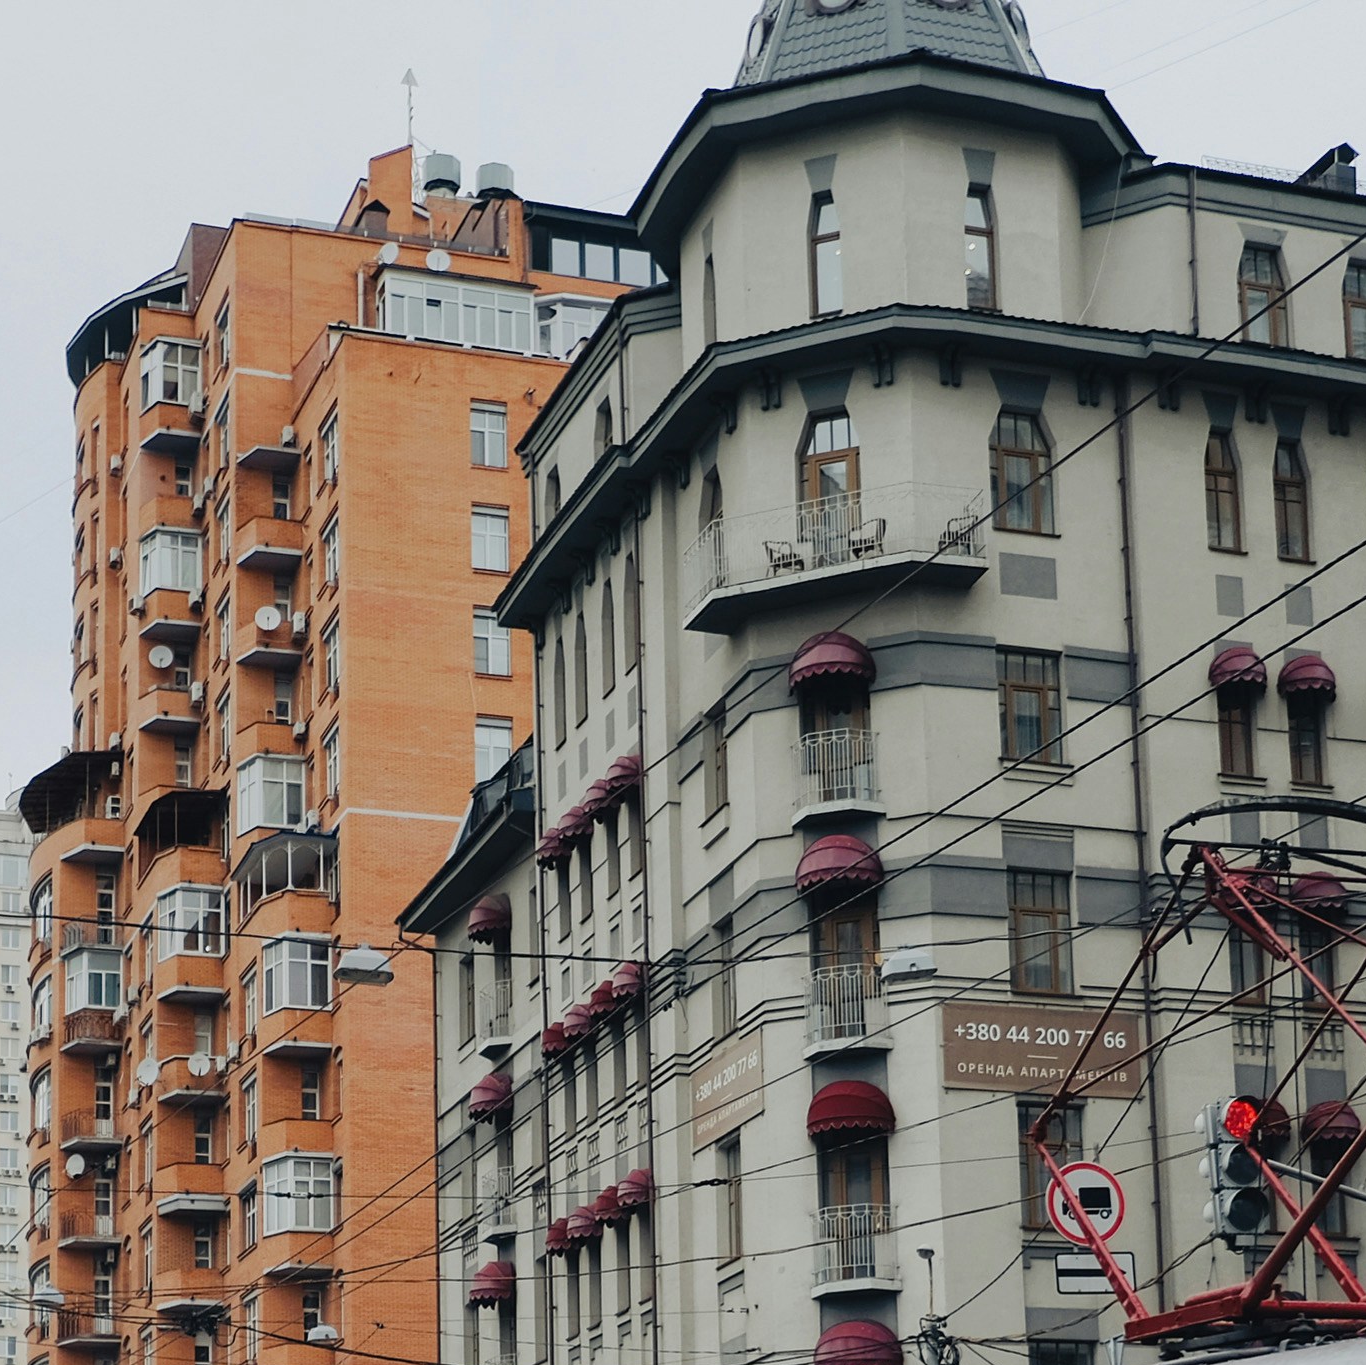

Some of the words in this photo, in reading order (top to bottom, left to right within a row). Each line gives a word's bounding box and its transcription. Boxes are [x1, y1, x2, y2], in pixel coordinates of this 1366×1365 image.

[954, 1022, 1001, 1042] +380
[1006, 1025, 1030, 1043] 44
[1035, 1027, 1070, 1046] 200
[1103, 1031, 1127, 1049] 66
[957, 1062, 1014, 1077] ОРЕНДА
[1020, 1066, 1128, 1083] АПАРТМЕНІВ
